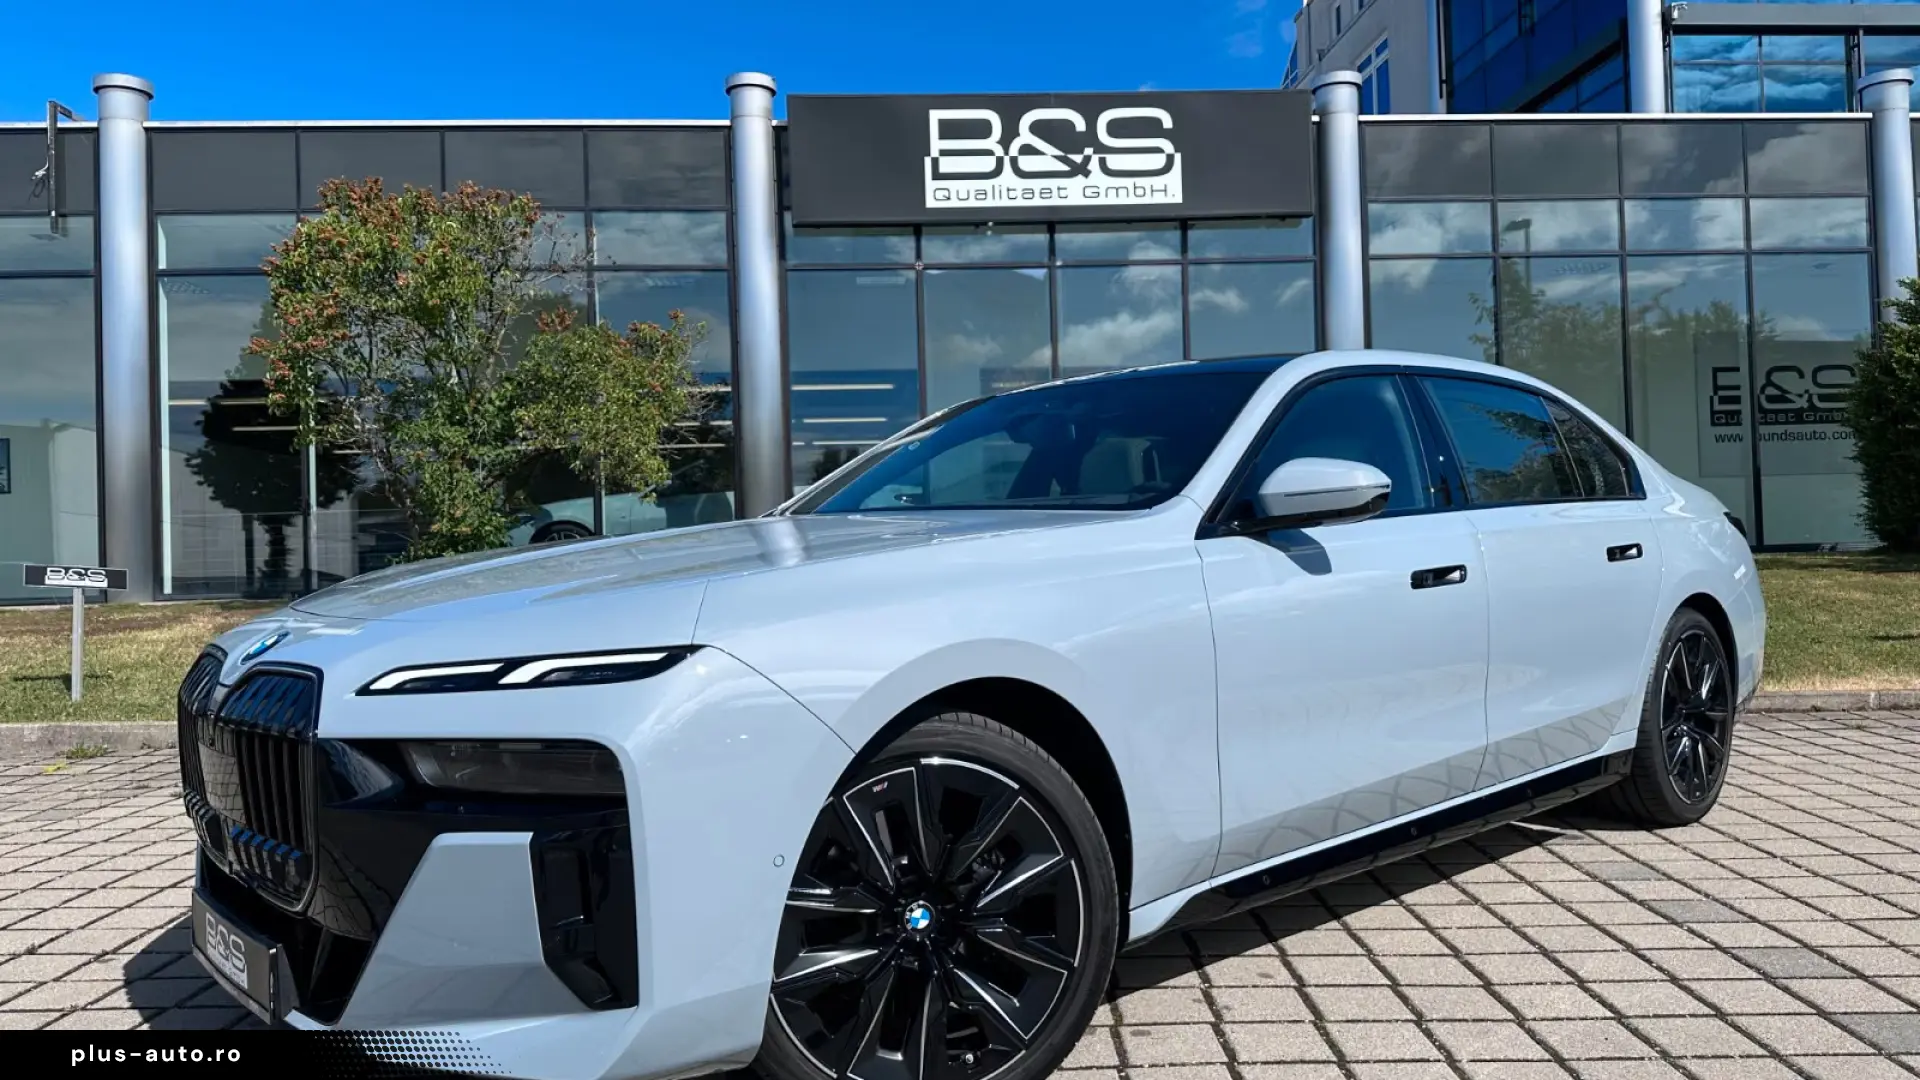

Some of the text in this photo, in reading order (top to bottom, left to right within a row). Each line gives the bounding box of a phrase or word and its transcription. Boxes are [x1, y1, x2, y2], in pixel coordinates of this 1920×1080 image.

[928, 107, 1175, 181] B&S
[932, 181, 1176, 202] Qualitaet GmbH.
[46, 567, 107, 583] B&S
